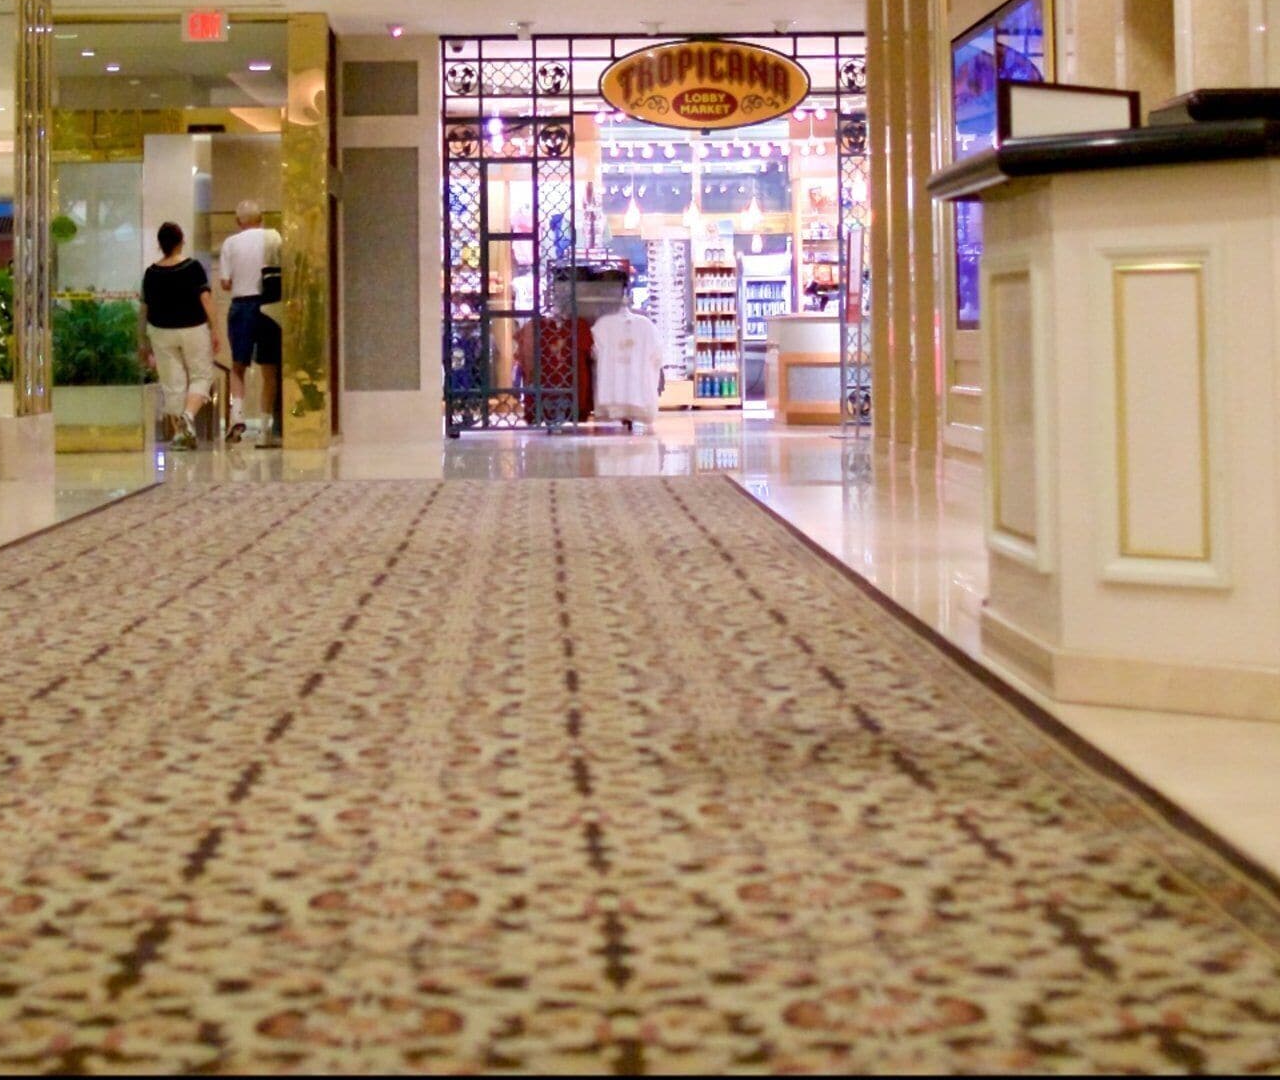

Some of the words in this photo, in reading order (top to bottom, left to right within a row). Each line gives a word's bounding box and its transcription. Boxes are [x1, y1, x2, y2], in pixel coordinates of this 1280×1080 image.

[617, 46, 791, 104] TROPICANA
[684, 92, 726, 103] LOBBY
[680, 104, 731, 115] MARKET
